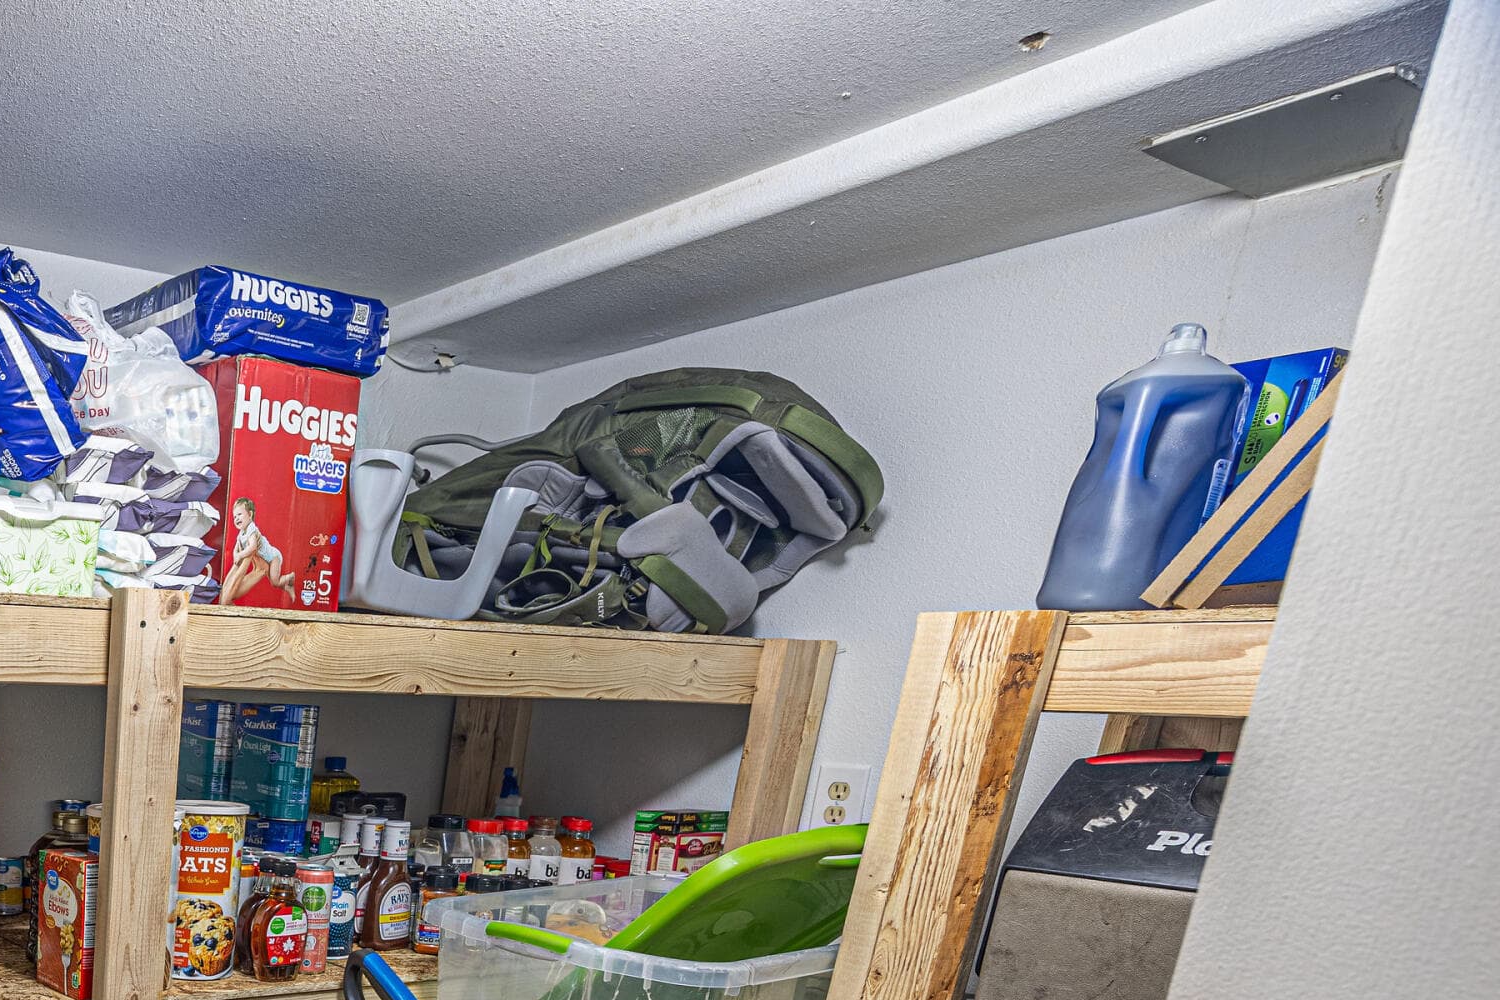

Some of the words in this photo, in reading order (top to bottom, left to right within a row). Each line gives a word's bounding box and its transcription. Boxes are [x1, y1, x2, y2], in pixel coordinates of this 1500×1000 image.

[230, 271, 334, 318] HUGGIES
[228, 304, 283, 326] overnites
[354, 348, 363, 360] 4
[88, 407, 110, 419] Day
[234, 383, 358, 448] HUGGIES
[295, 456, 345, 477] movers
[303, 580, 317, 590] 124
[317, 570, 333, 597] 5
[597, 592, 605, 618] KELTY
[243, 719, 277, 730] StarKist
[311, 826, 320, 835] 12
[184, 845, 230, 853] FASHIONED
[331, 901, 349, 909] Plain
[390, 892, 410, 905] RAY'S
[48, 902, 70, 916] Elbows
[332, 909, 347, 918] Salt
